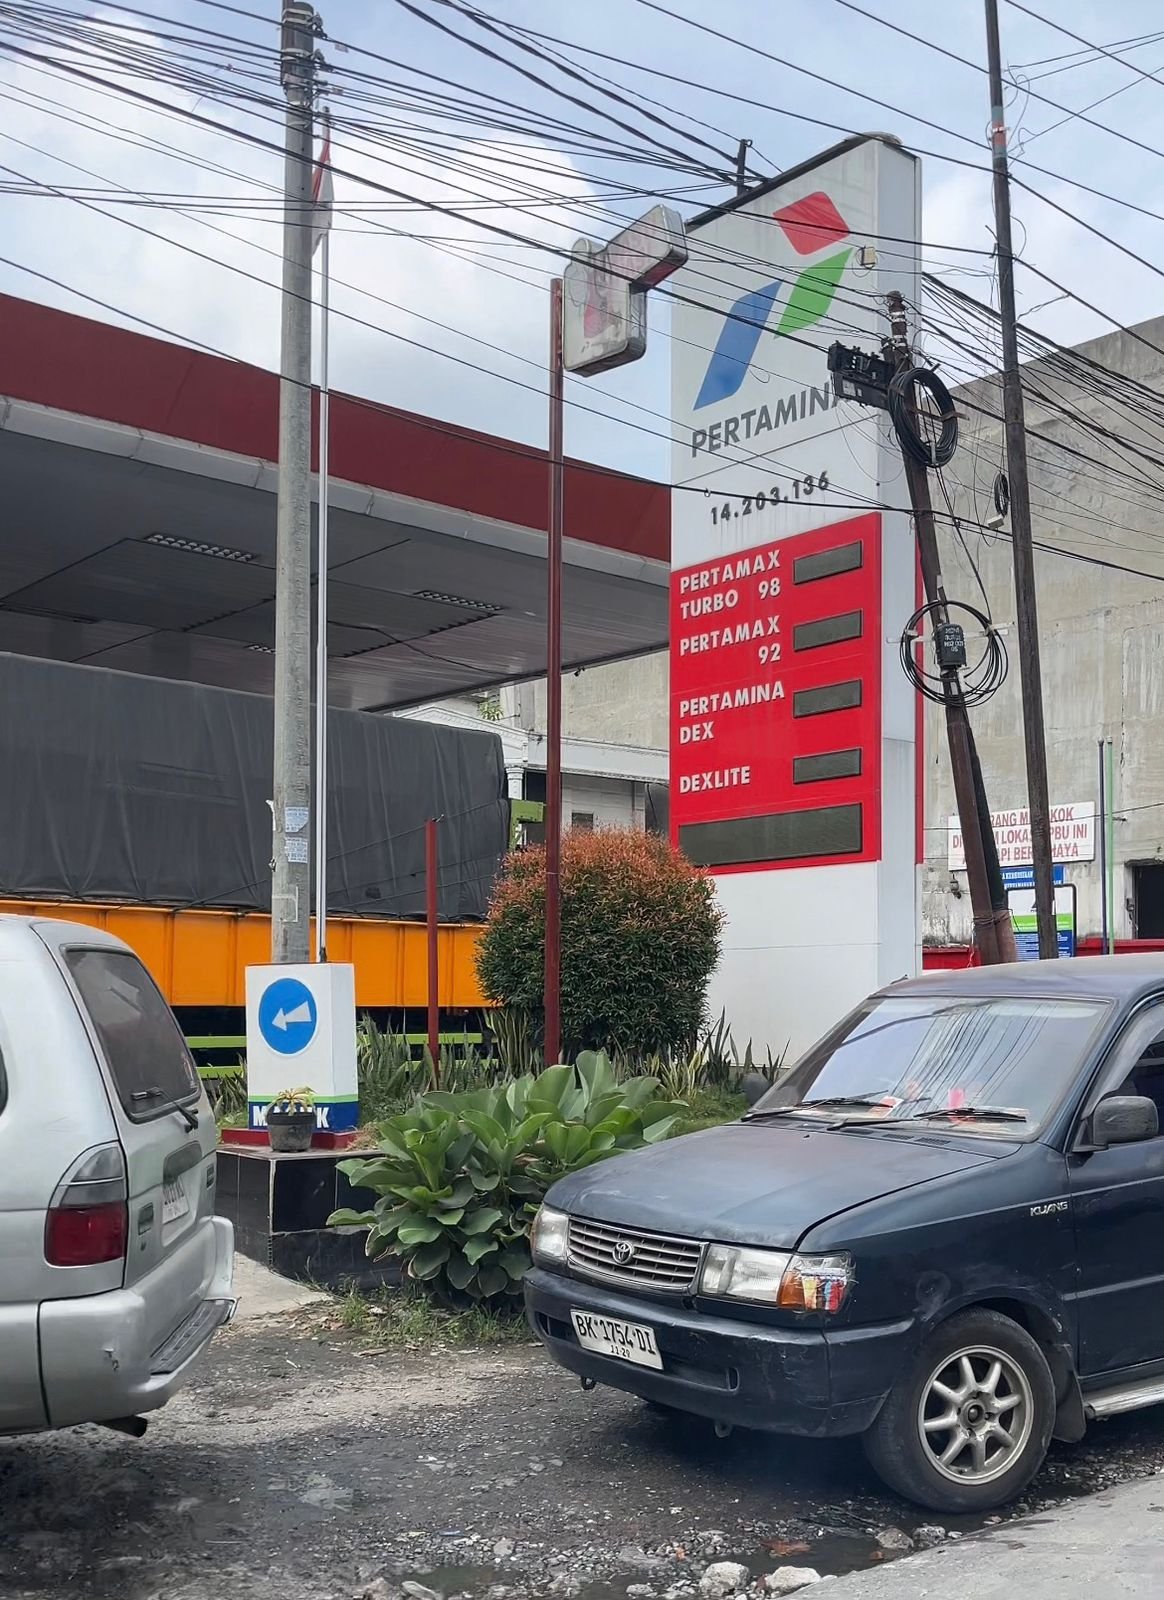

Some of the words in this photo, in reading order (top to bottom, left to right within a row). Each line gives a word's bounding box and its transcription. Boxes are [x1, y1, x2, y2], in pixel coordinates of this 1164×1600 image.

[711, 470, 829, 525] 14.203.136
[680, 549, 780, 594] PERTAMAX
[680, 589, 738, 620] TURBO
[759, 577, 780, 600] 98
[680, 615, 780, 656] PERTAMAX
[758, 643, 780, 665] 92
[680, 680, 785, 718] PERTAMINA
[680, 721, 714, 744] DEX
[680, 766, 750, 794] DEXLITE
[1020, 806, 1074, 825] MKOK
[1002, 829, 1032, 844] LOKA
[1050, 824, 1069, 840] PBU
[1073, 823, 1087, 839] INI
